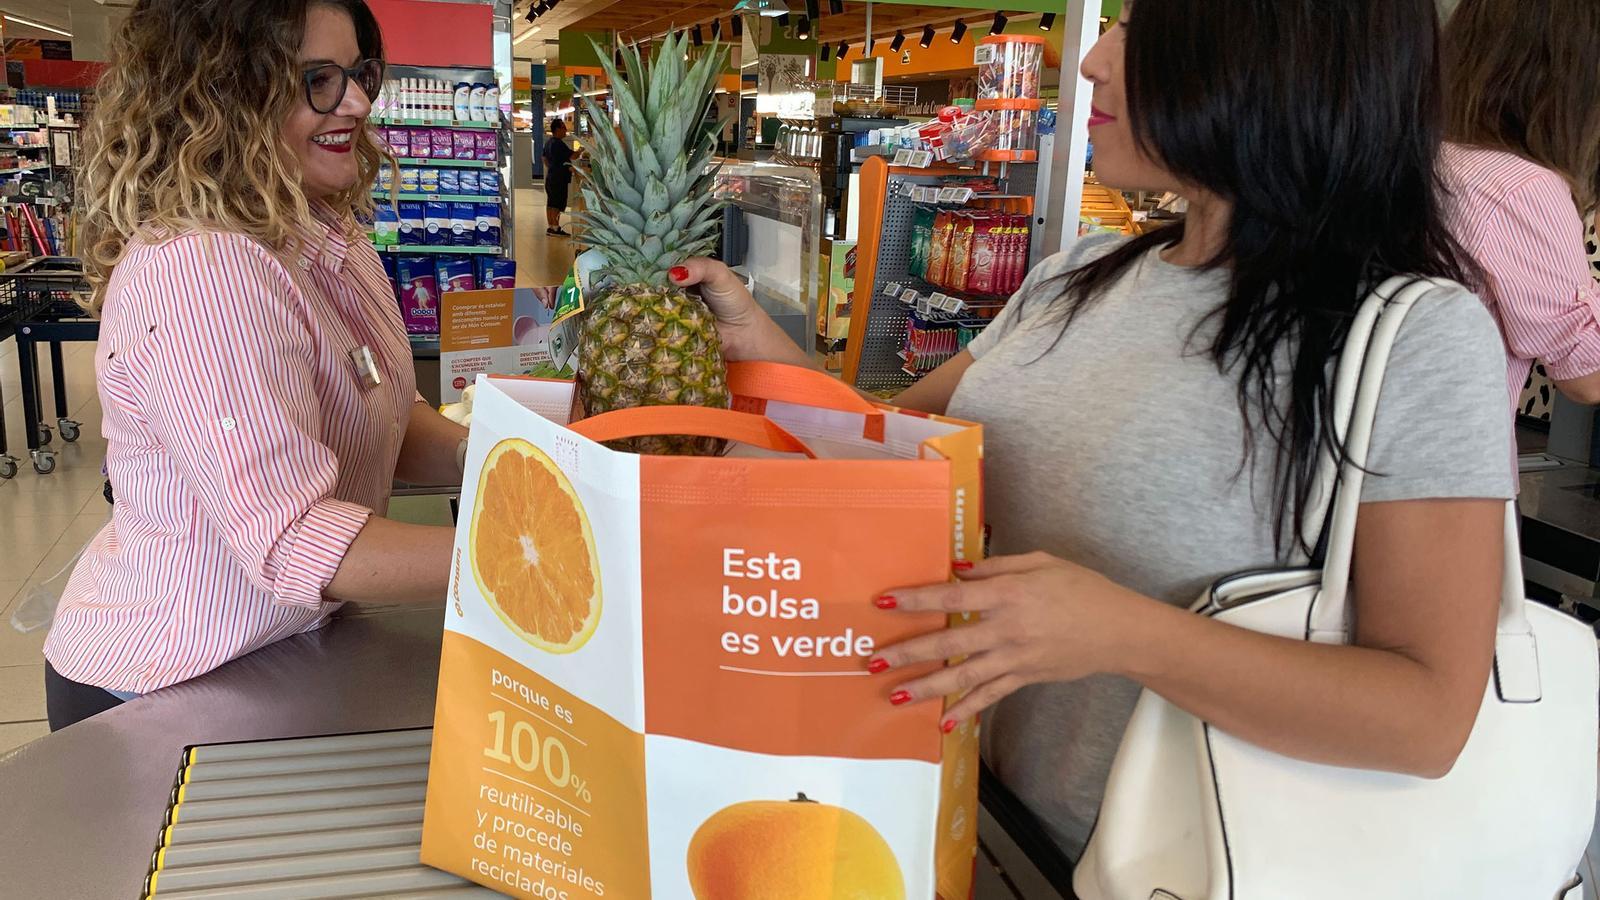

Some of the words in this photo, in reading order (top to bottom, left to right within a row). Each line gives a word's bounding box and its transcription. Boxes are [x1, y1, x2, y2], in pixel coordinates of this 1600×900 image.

[954, 488, 965, 560] nsum
[722, 547, 801, 581] Esta
[722, 585, 820, 620] bolsa
[720, 630, 760, 655] es
[771, 628, 875, 658] verde
[491, 667, 550, 710] porque
[554, 704, 574, 724] es
[483, 709, 592, 804] 100%
[475, 809, 488, 828] y
[492, 815, 573, 857] procede
[479, 783, 584, 838] reutilizable
[471, 856, 569, 900] reciclados
[473, 831, 497, 854] de
[503, 843, 605, 897] materiales
